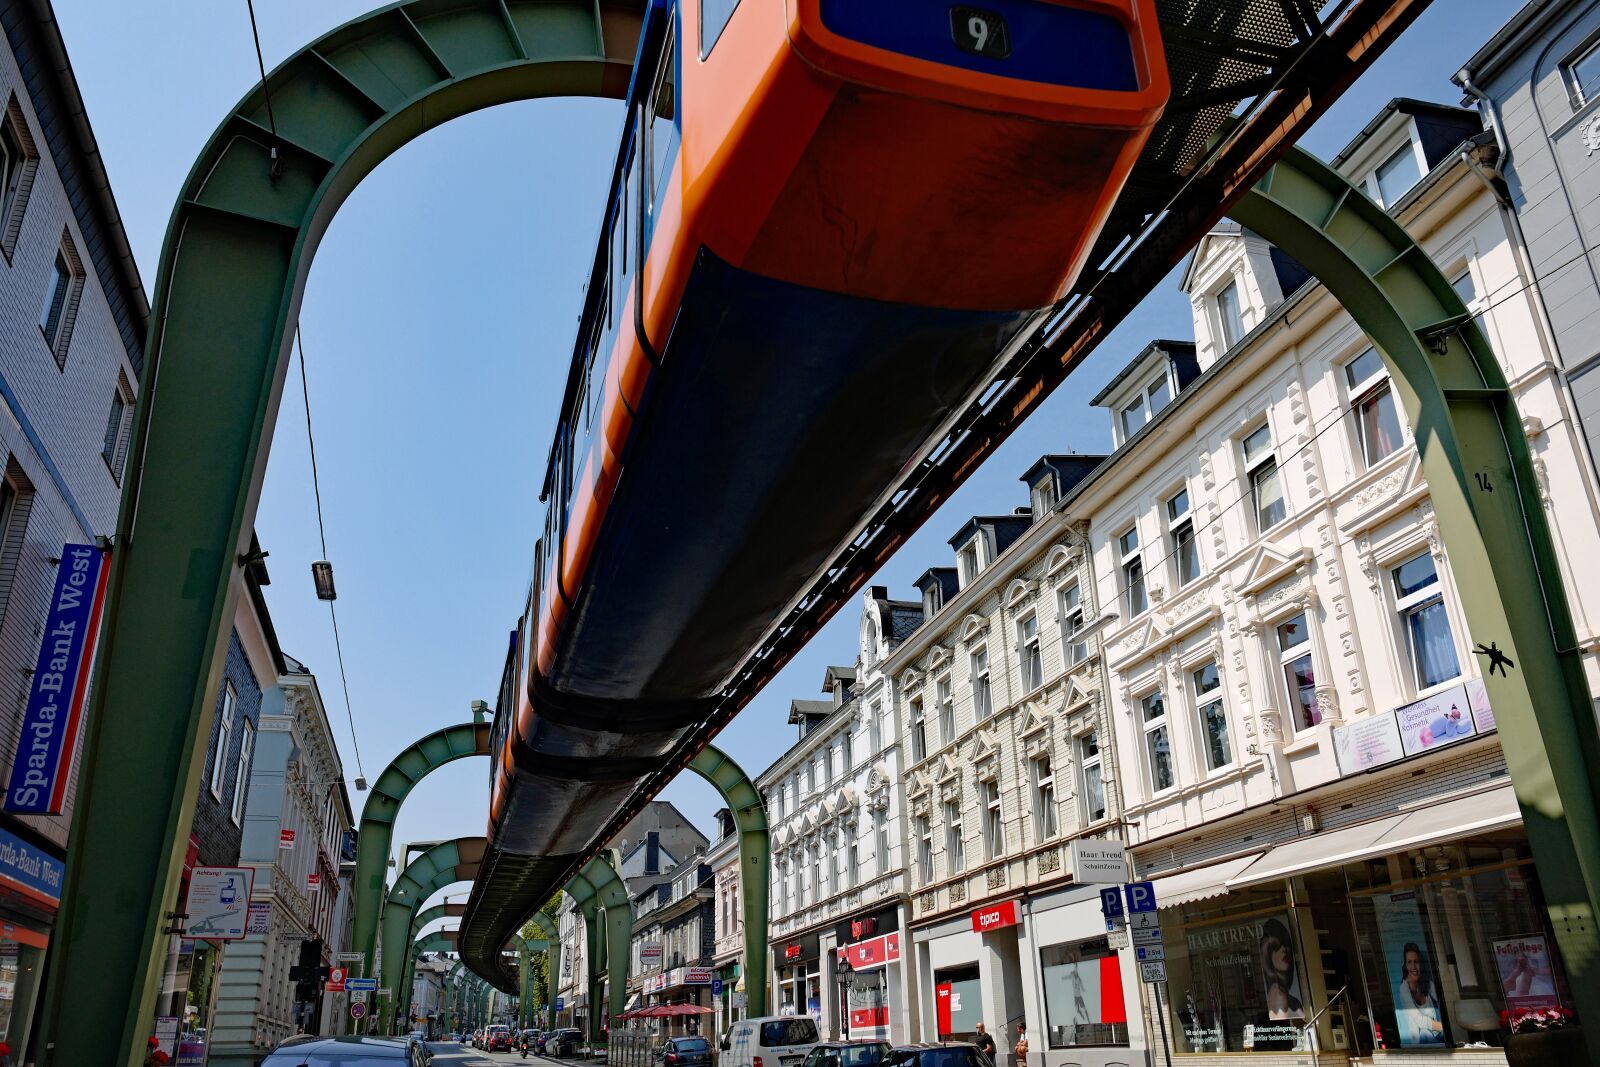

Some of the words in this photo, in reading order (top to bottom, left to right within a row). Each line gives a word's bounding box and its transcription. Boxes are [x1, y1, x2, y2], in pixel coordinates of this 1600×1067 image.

[968, 17, 988, 51] 9
[1475, 472, 1493, 492] 14
[14, 620, 76, 807] Sparda-Bank
[58, 549, 92, 613] West
[1402, 718, 1429, 732] Kosmetik
[0, 841, 41, 878] rda-Bank
[42, 861, 60, 888] West
[751, 856, 758, 865] 13
[1080, 851, 1098, 859] Haar
[1101, 851, 1122, 859] Trend
[1105, 892, 1117, 914] P
[1132, 886, 1148, 909] P
[979, 911, 1000, 928] tipico
[1187, 930, 1220, 950] HAAR
[1221, 924, 1264, 944] TREND
[1497, 943, 1543, 955] Fußpflege
